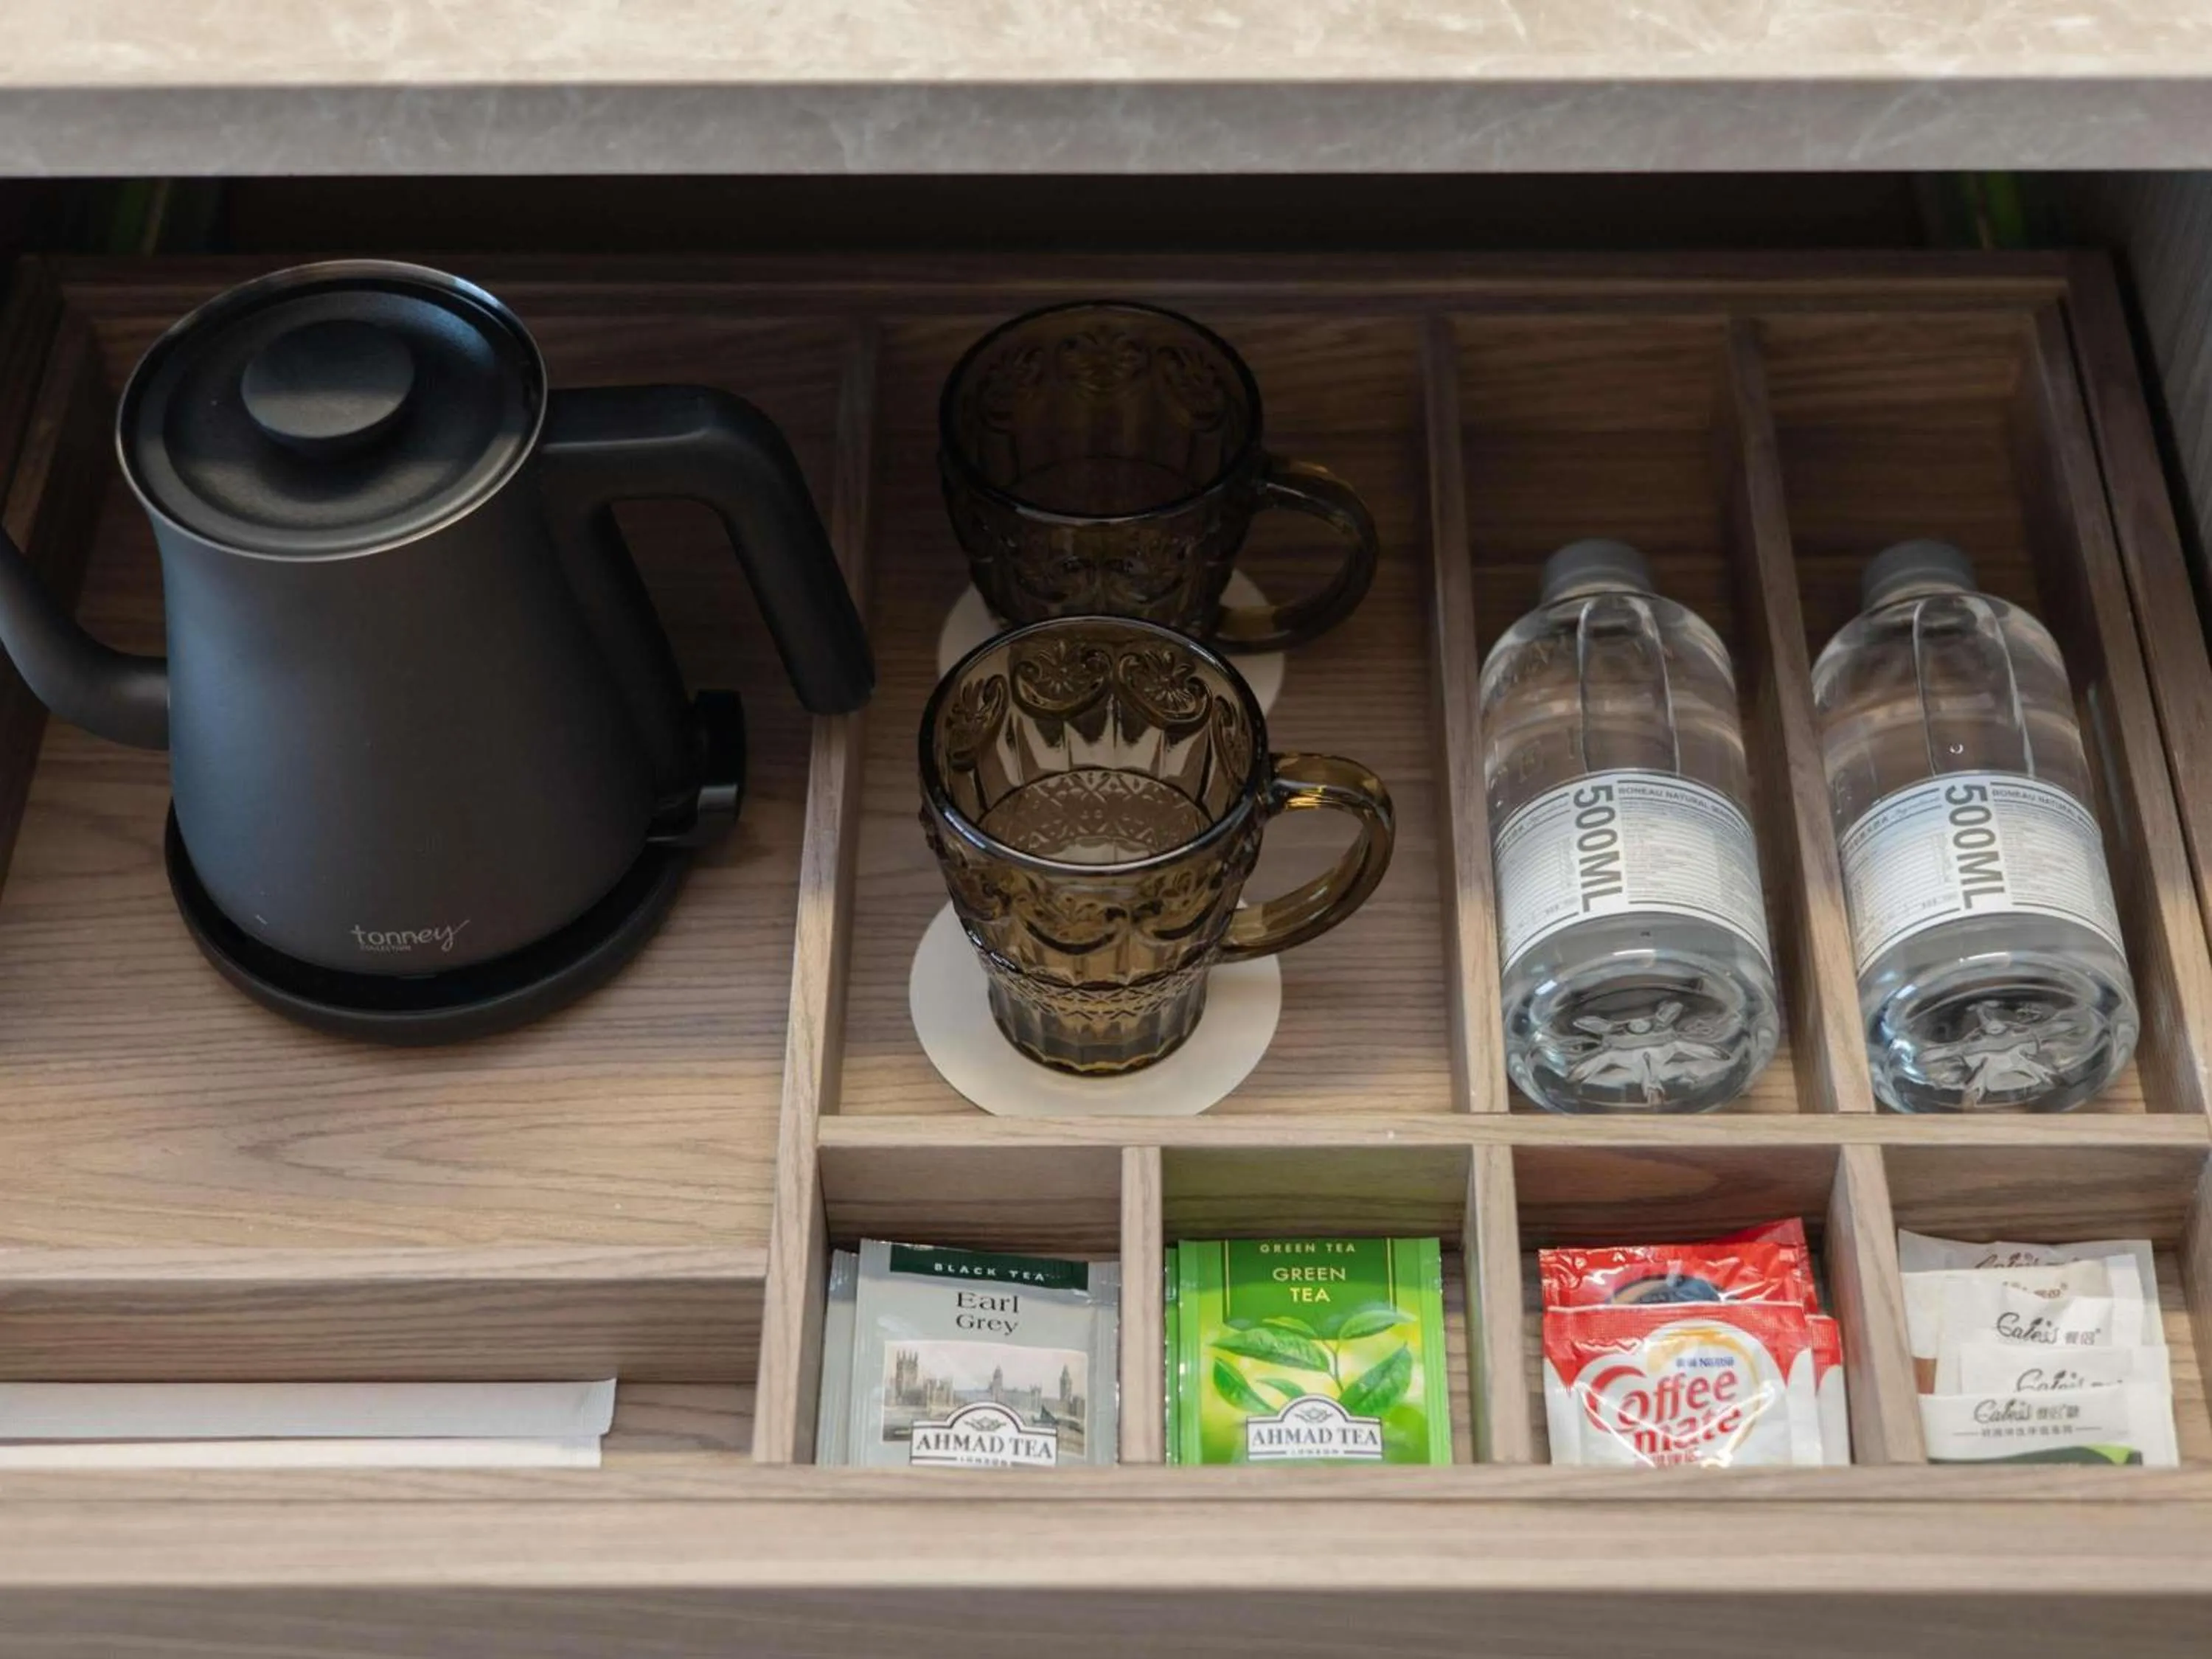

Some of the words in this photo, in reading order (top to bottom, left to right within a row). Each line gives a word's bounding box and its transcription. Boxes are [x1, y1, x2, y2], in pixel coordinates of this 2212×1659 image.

[1574, 785, 1623, 913] 500ML
[1945, 784, 2005, 909] 500ML
[350, 919, 470, 952] tonney
[1259, 1243, 1315, 1254] GREEN
[1326, 1242, 1356, 1253] TEA
[933, 1262, 996, 1277] BLACK
[1009, 1270, 1044, 1281] TEA
[1272, 1267, 1346, 1281] GREEN
[956, 1290, 1020, 1314] Earl
[1290, 1287, 1331, 1303] TEA
[955, 1314, 1019, 1336] Grey
[1585, 1366, 1739, 1434] Coffee
[916, 1433, 1004, 1454] AHMAD
[1009, 1437, 1053, 1459] TEA
[1252, 1427, 1333, 1445] AHMAD
[1338, 1429, 1378, 1445] TEA
